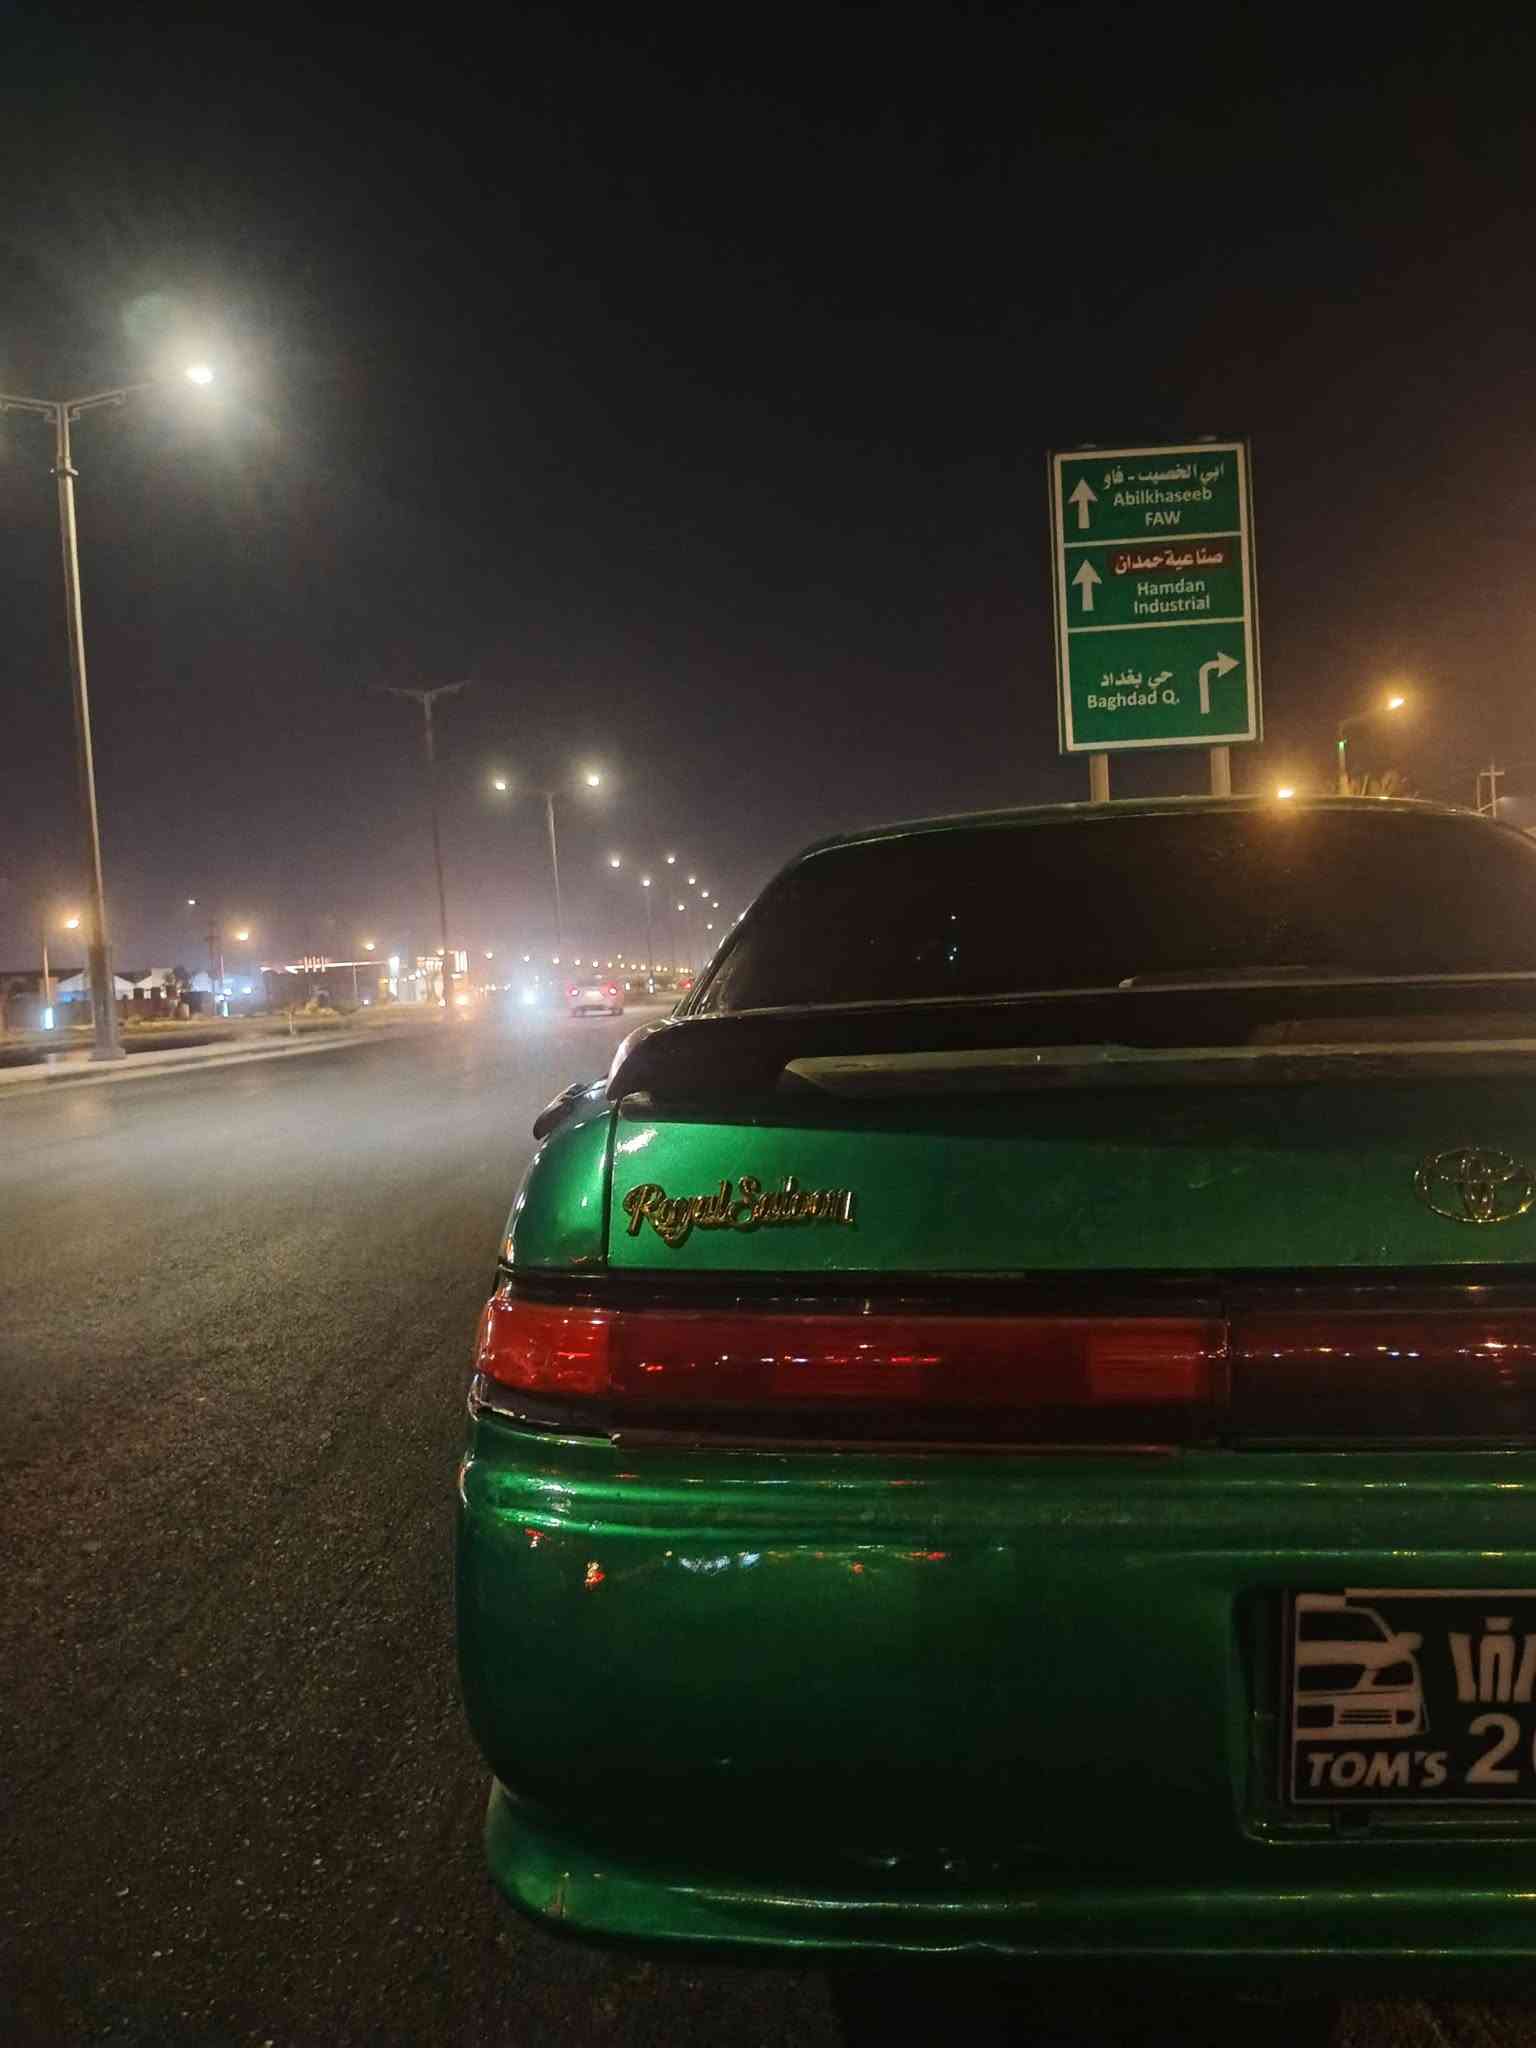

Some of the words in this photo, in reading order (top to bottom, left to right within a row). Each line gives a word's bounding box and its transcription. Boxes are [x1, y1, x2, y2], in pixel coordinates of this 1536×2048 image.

[1112, 486, 1213, 507] Abilkhaseeb
[1144, 511, 1181, 526] FAW
[1136, 578, 1205, 596] Hamdan
[1133, 595, 1211, 614] Industrial
[1100, 668, 1143, 689] بغداد
[1087, 690, 1158, 711] Baghdad
[1161, 689, 1181, 705] Q.
[622, 1179, 738, 1249] Royal
[1306, 1750, 1449, 1788] TOM'S
